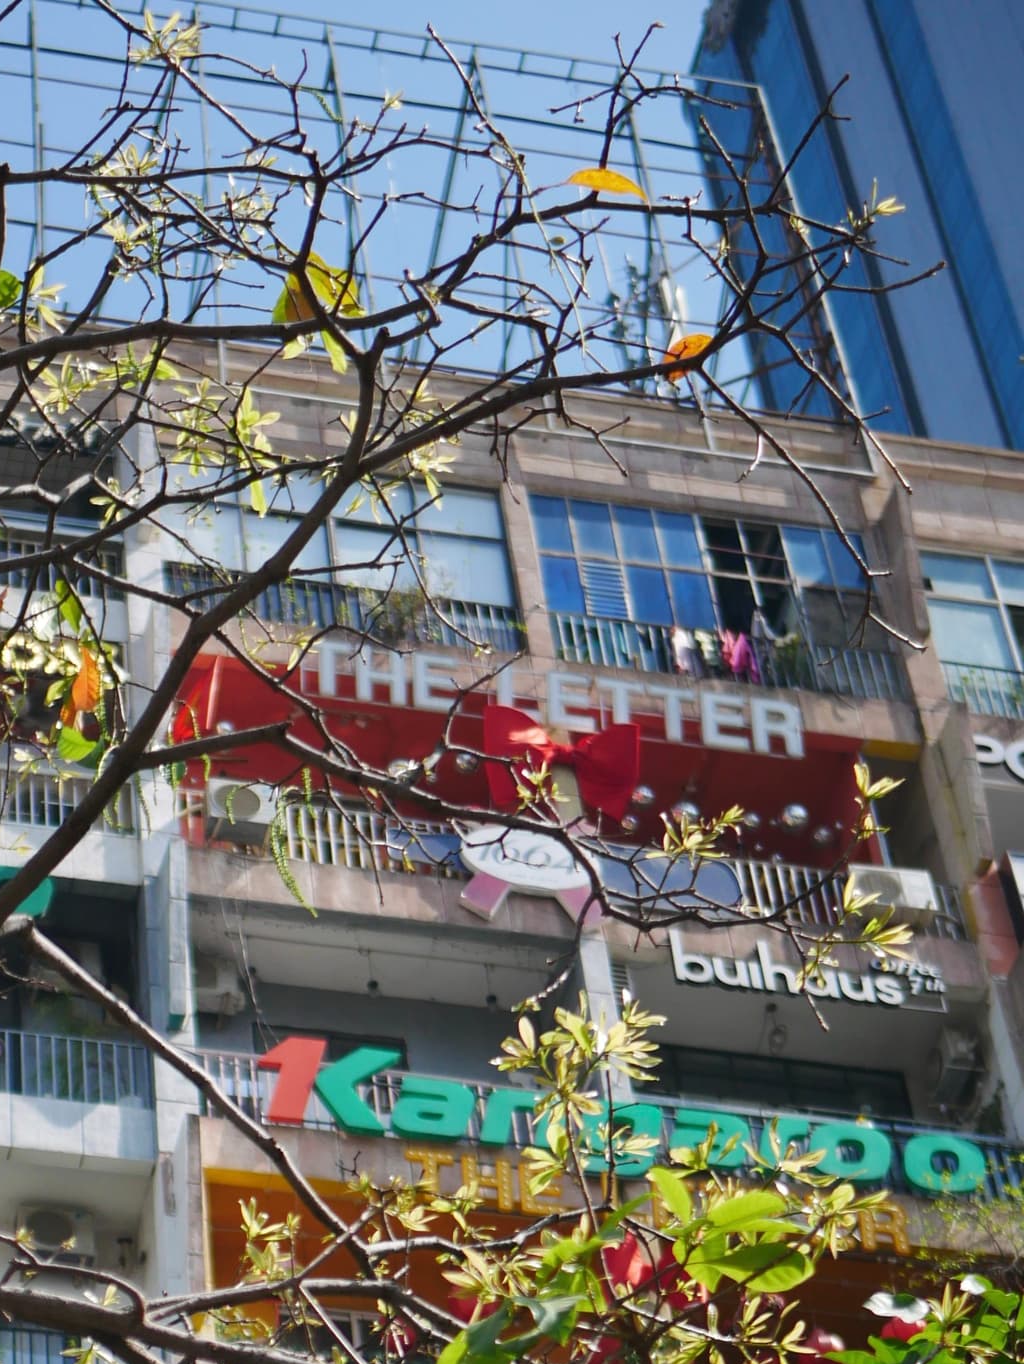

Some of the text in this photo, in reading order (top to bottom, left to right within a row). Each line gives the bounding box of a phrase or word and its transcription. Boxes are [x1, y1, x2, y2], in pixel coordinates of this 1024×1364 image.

[317, 641, 804, 758] THE LETTER
[404, 1146, 578, 1219] THE
